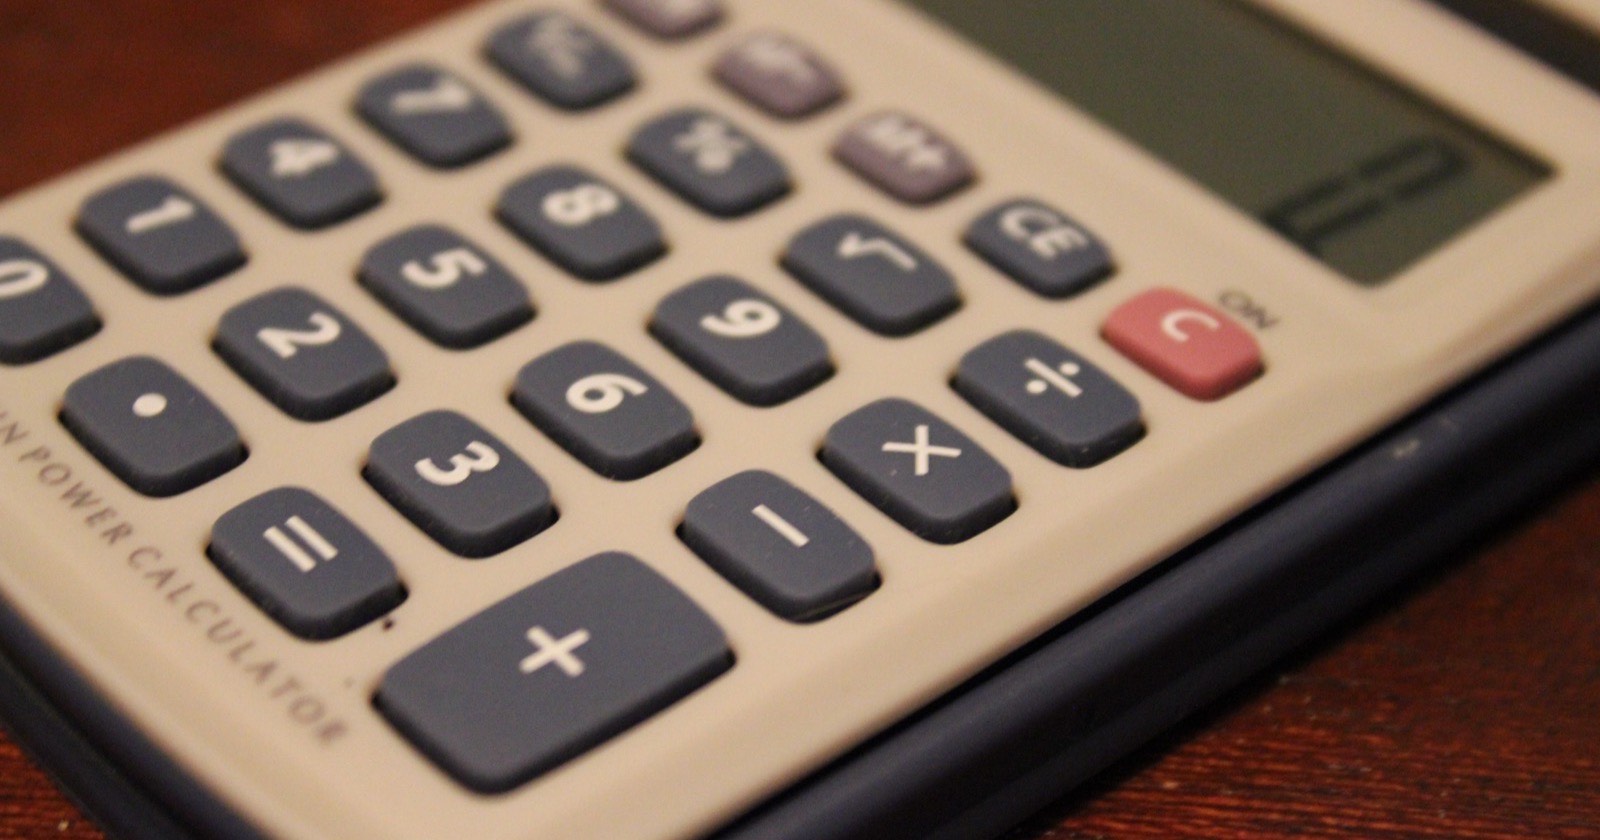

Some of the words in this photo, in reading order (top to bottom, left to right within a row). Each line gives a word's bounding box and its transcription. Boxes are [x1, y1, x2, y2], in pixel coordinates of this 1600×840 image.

[393, 79, 472, 112] 7
[269, 137, 338, 177] 4
[126, 195, 194, 234] 1
[542, 183, 619, 226] 8
[1001, 205, 1089, 260] CE
[401, 247, 487, 290] 5
[701, 298, 782, 338] 9
[1160, 309, 1220, 343] C
[1218, 290, 1282, 330] ON
[257, 312, 342, 359] 2
[564, 372, 648, 414] 6
[413, 439, 501, 487] 3
[18, 445, 133, 546] POWER
[127, 546, 348, 745] CALCULATOR
